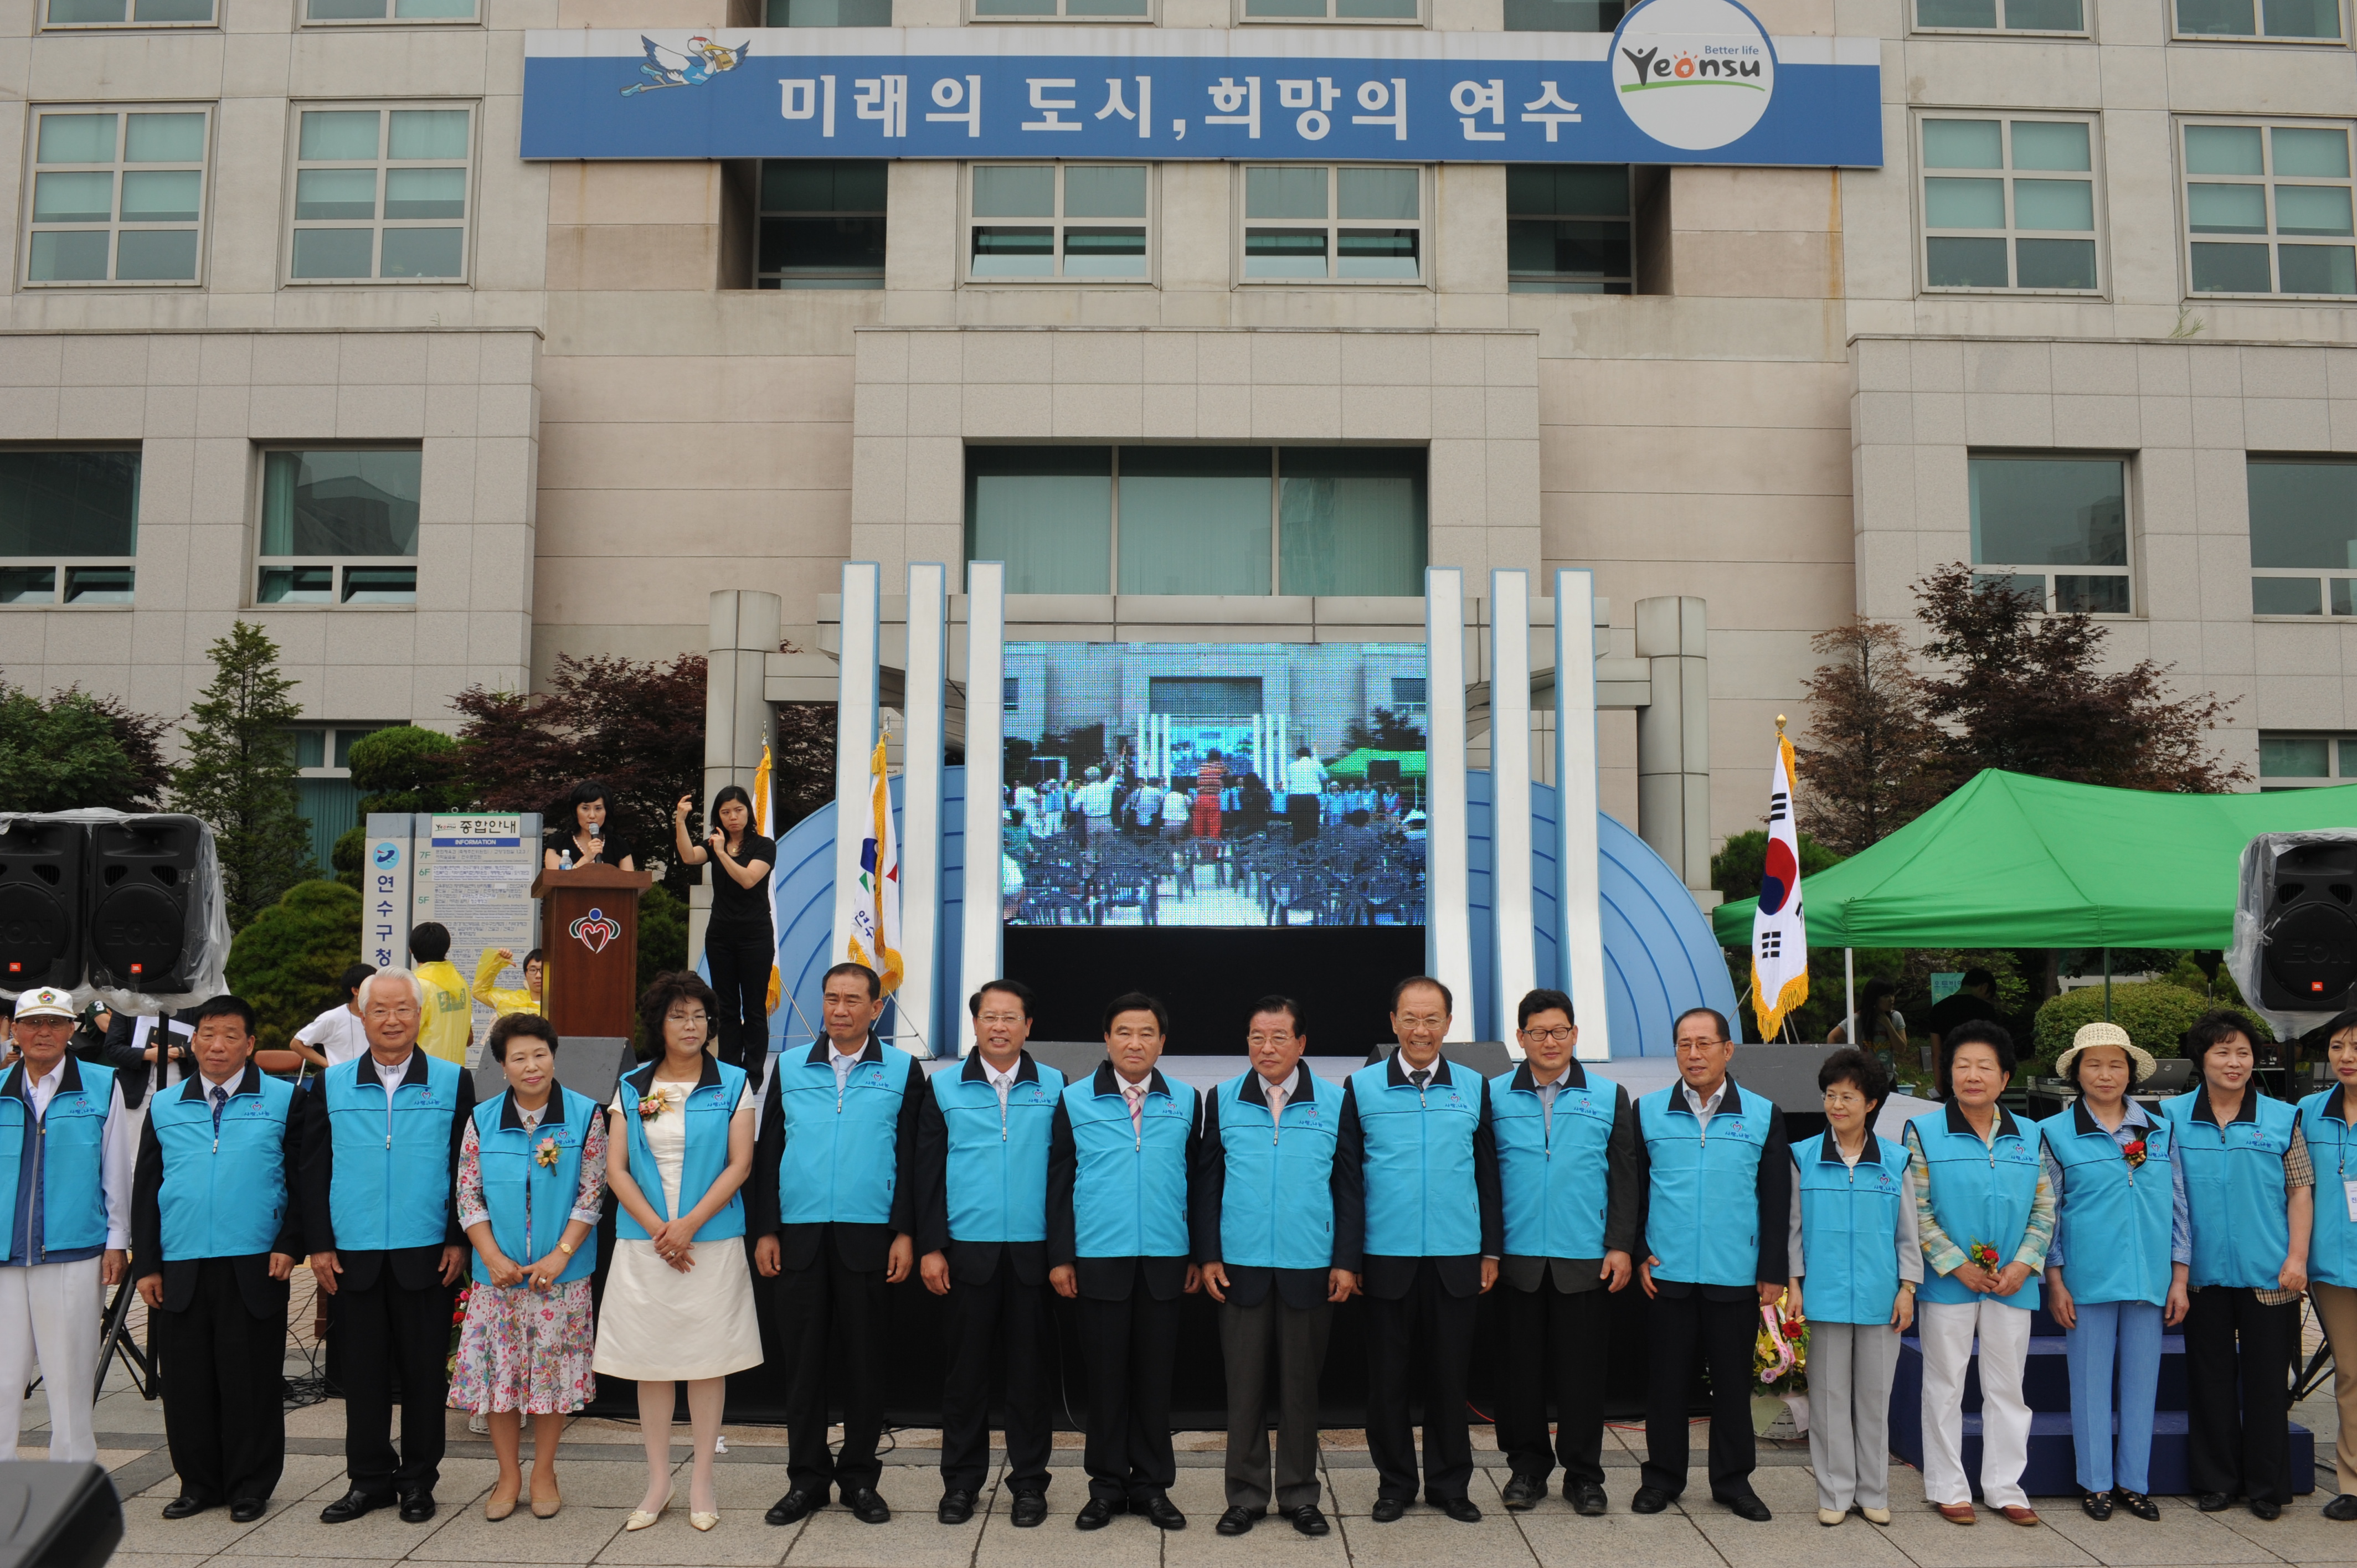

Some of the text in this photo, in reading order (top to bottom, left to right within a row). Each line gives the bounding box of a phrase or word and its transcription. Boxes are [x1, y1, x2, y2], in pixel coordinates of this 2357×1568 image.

[1705, 45, 1759, 55] Better life
[1622, 46, 1761, 86] Yeonsu
[778, 75, 981, 137] 미래의
[1205, 76, 1407, 140] 희망의
[1450, 79, 1581, 142] 연수
[460, 821, 516, 834] 종합안내
[0, 920, 53, 943] ON
[105, 920, 170, 945] EON
[375, 875, 394, 967] 연수구청
[2284, 939, 2351, 963] EON
[95, 1000, 105, 1011] 3
